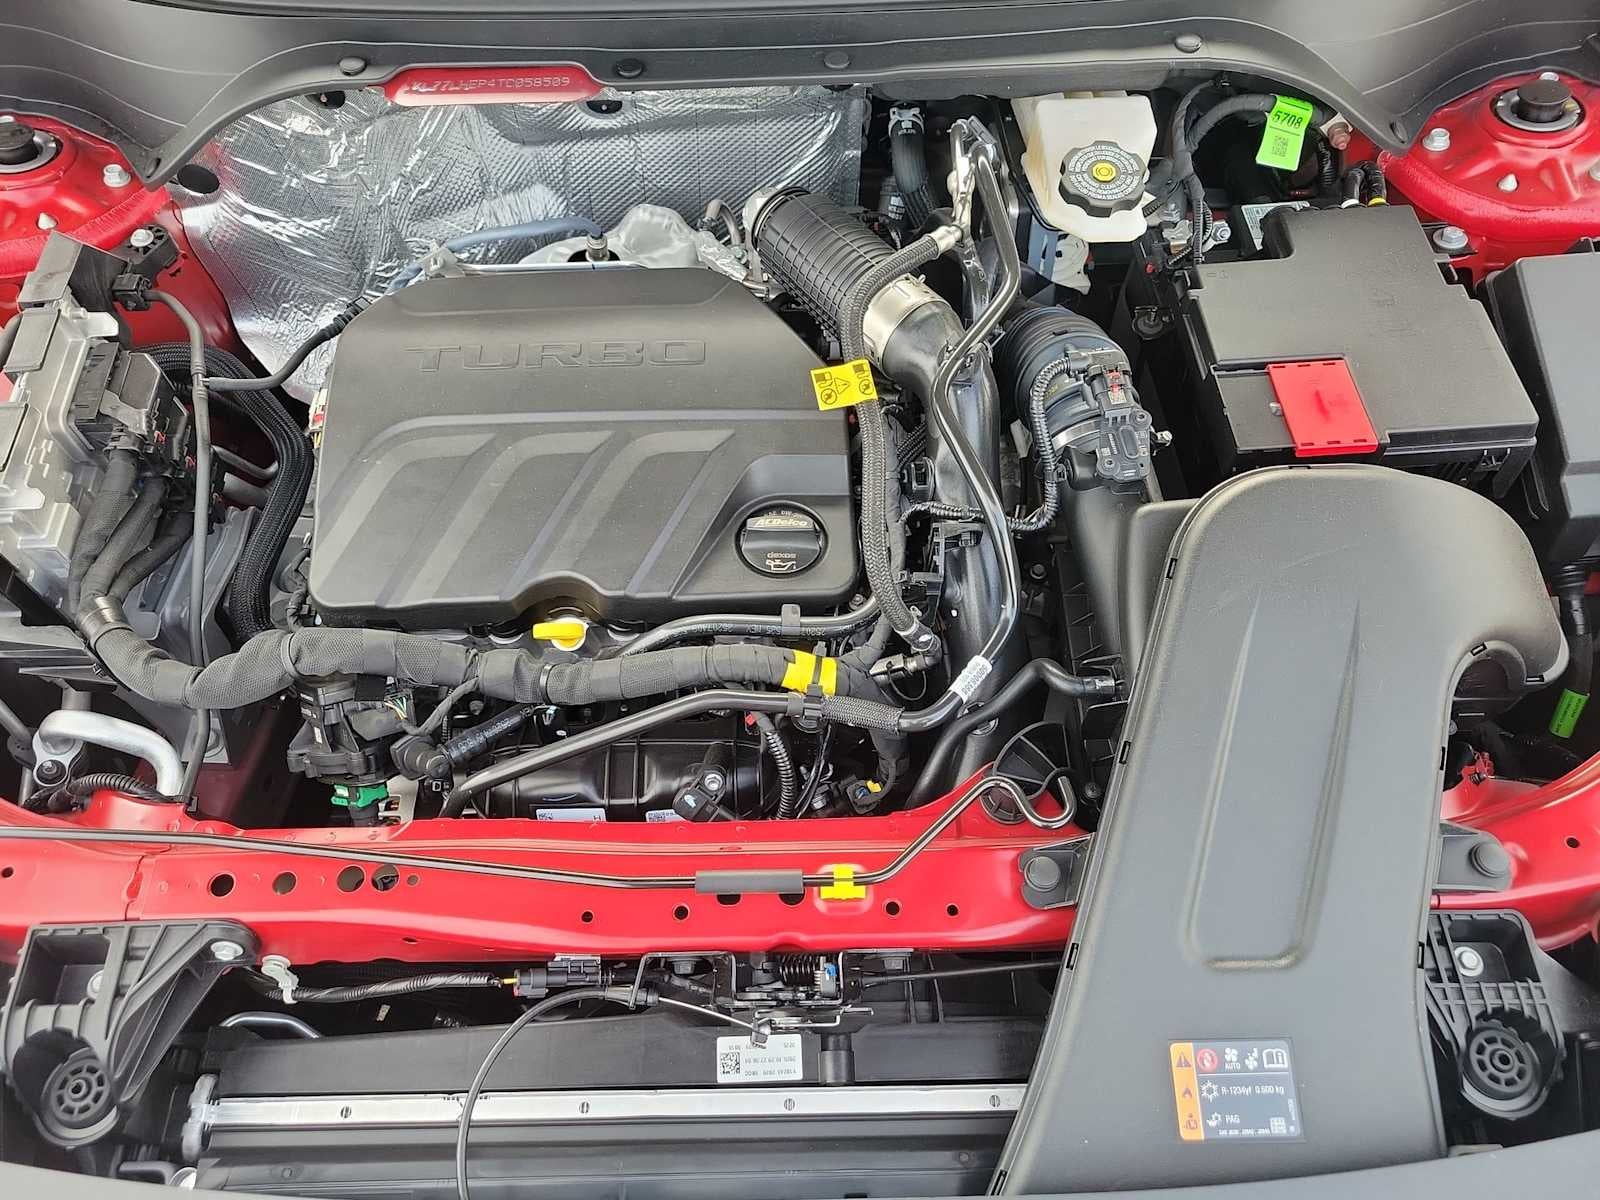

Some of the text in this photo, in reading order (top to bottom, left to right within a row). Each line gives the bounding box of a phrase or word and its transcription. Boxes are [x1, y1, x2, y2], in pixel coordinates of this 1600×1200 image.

[1272, 110, 1304, 129] 5708
[404, 339, 707, 373] TURBO
[766, 551, 797, 559] dexos
